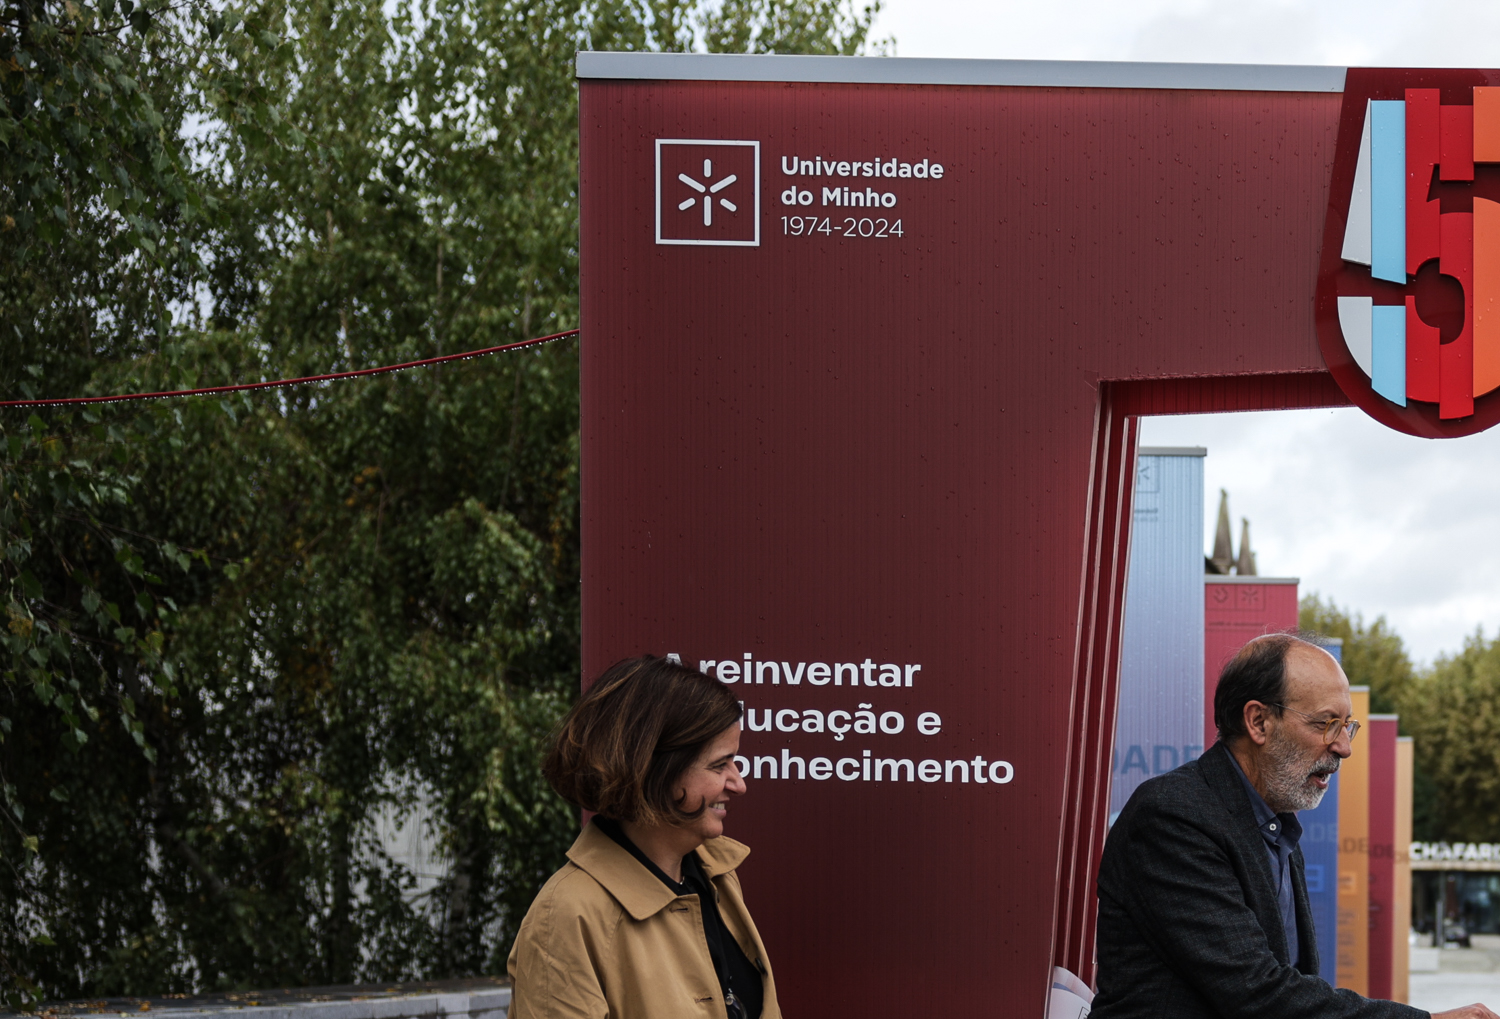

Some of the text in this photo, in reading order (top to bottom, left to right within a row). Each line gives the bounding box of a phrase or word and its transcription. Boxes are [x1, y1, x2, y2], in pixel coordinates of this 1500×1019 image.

[781, 155, 944, 179] Universidade
[781, 185, 897, 208] do Minho
[780, 215, 904, 238] 1974-2024
[699, 652, 922, 688] reinventar
[738, 700, 942, 742] ucação e
[733, 749, 1013, 783] onhecimento
